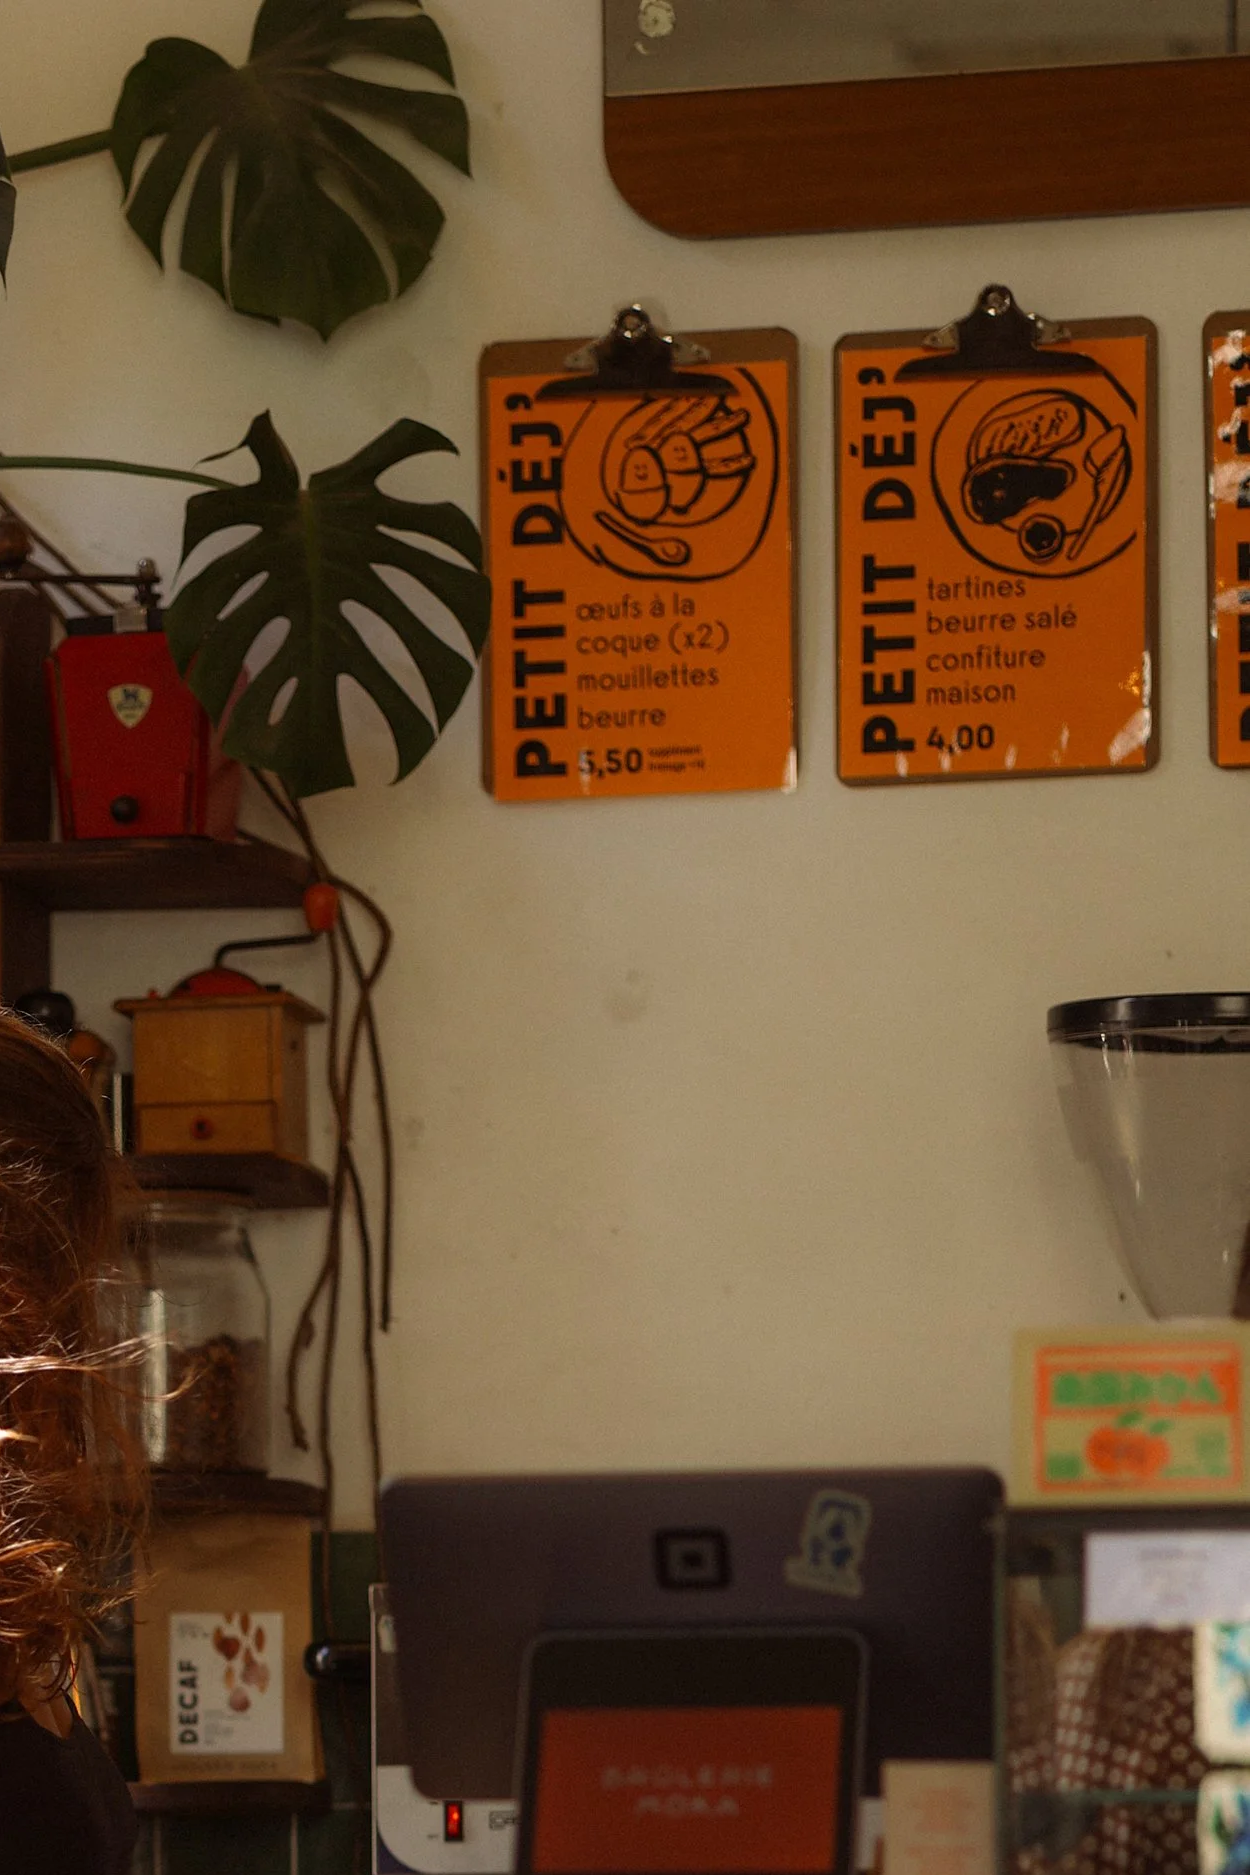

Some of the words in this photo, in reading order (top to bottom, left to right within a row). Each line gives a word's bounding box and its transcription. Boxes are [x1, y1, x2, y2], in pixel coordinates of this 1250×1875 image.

[927, 575, 1026, 601] tartines
[650, 593, 665, 618] à
[673, 592, 695, 616] la
[926, 609, 1016, 635] beurre
[1025, 603, 1078, 631] salé
[576, 633, 660, 658] coque
[668, 619, 729, 655] (x2)
[862, 554, 915, 755] PETIT
[926, 644, 1046, 672] confiture
[512, 579, 566, 778] PETIT
[577, 662, 719, 691] mouillettes
[926, 680, 1016, 706] maison
[577, 705, 666, 729] beurre
[178, 1660, 198, 1745] DECAF
